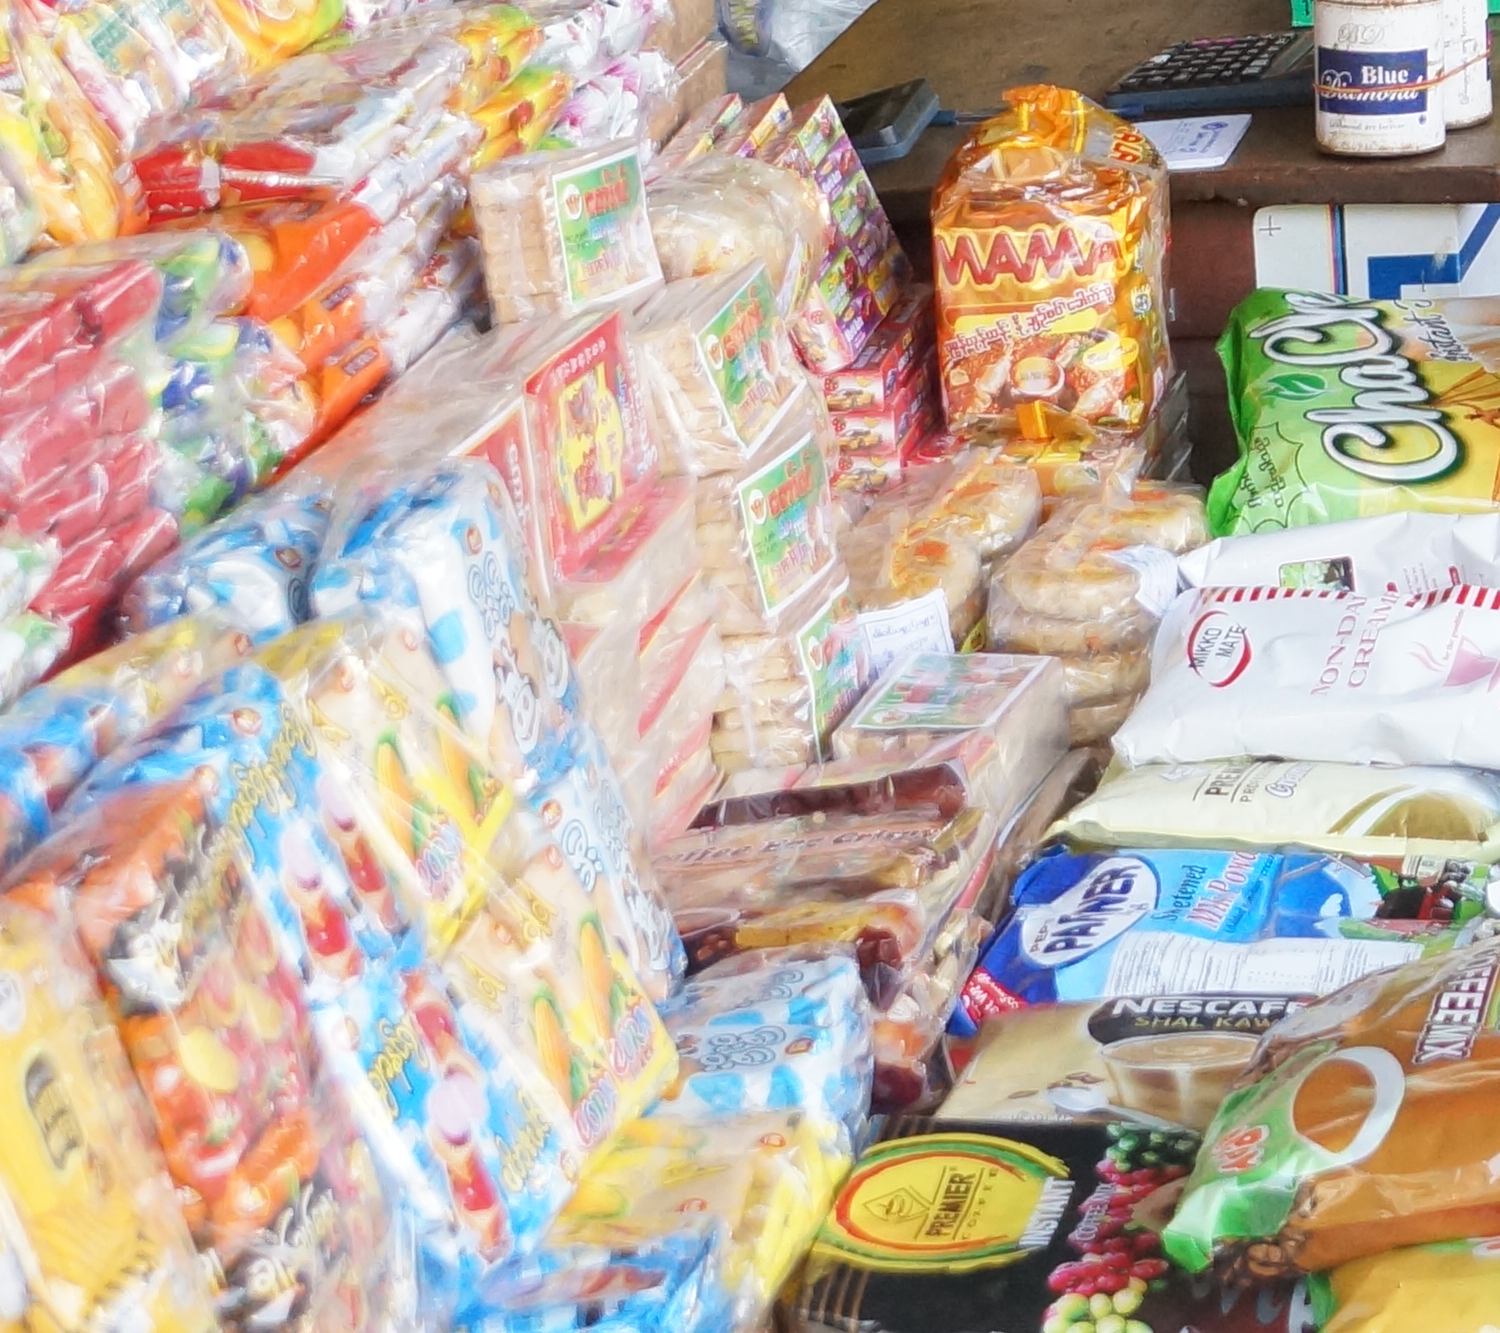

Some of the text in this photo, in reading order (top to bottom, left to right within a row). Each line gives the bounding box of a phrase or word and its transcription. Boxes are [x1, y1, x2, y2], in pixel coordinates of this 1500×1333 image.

[1361, 66, 1409, 85] Blue
[1189, 623, 1247, 669] MIKKO MATE
[925, 1169, 977, 1240] PREMIER
[1018, 1176, 1074, 1249] INSTANT
